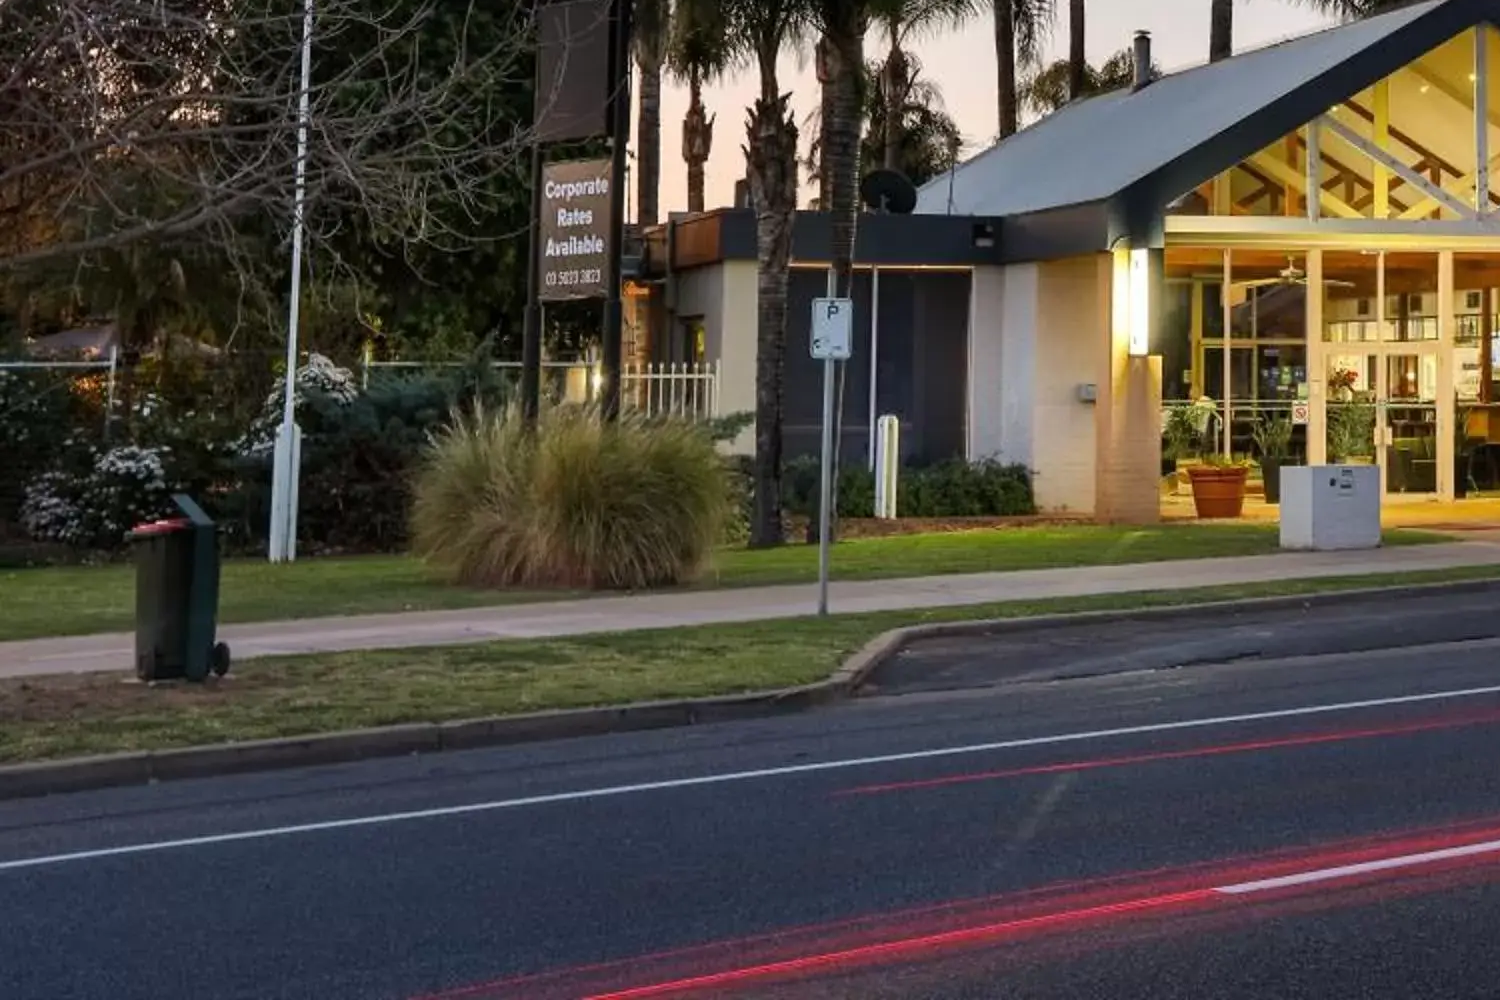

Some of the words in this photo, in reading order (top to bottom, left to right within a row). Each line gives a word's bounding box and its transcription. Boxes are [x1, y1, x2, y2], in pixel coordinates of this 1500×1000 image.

[545, 178, 609, 201] Corporate
[557, 207, 593, 227] Rates
[545, 234, 604, 257] Available
[827, 305, 839, 320] P
